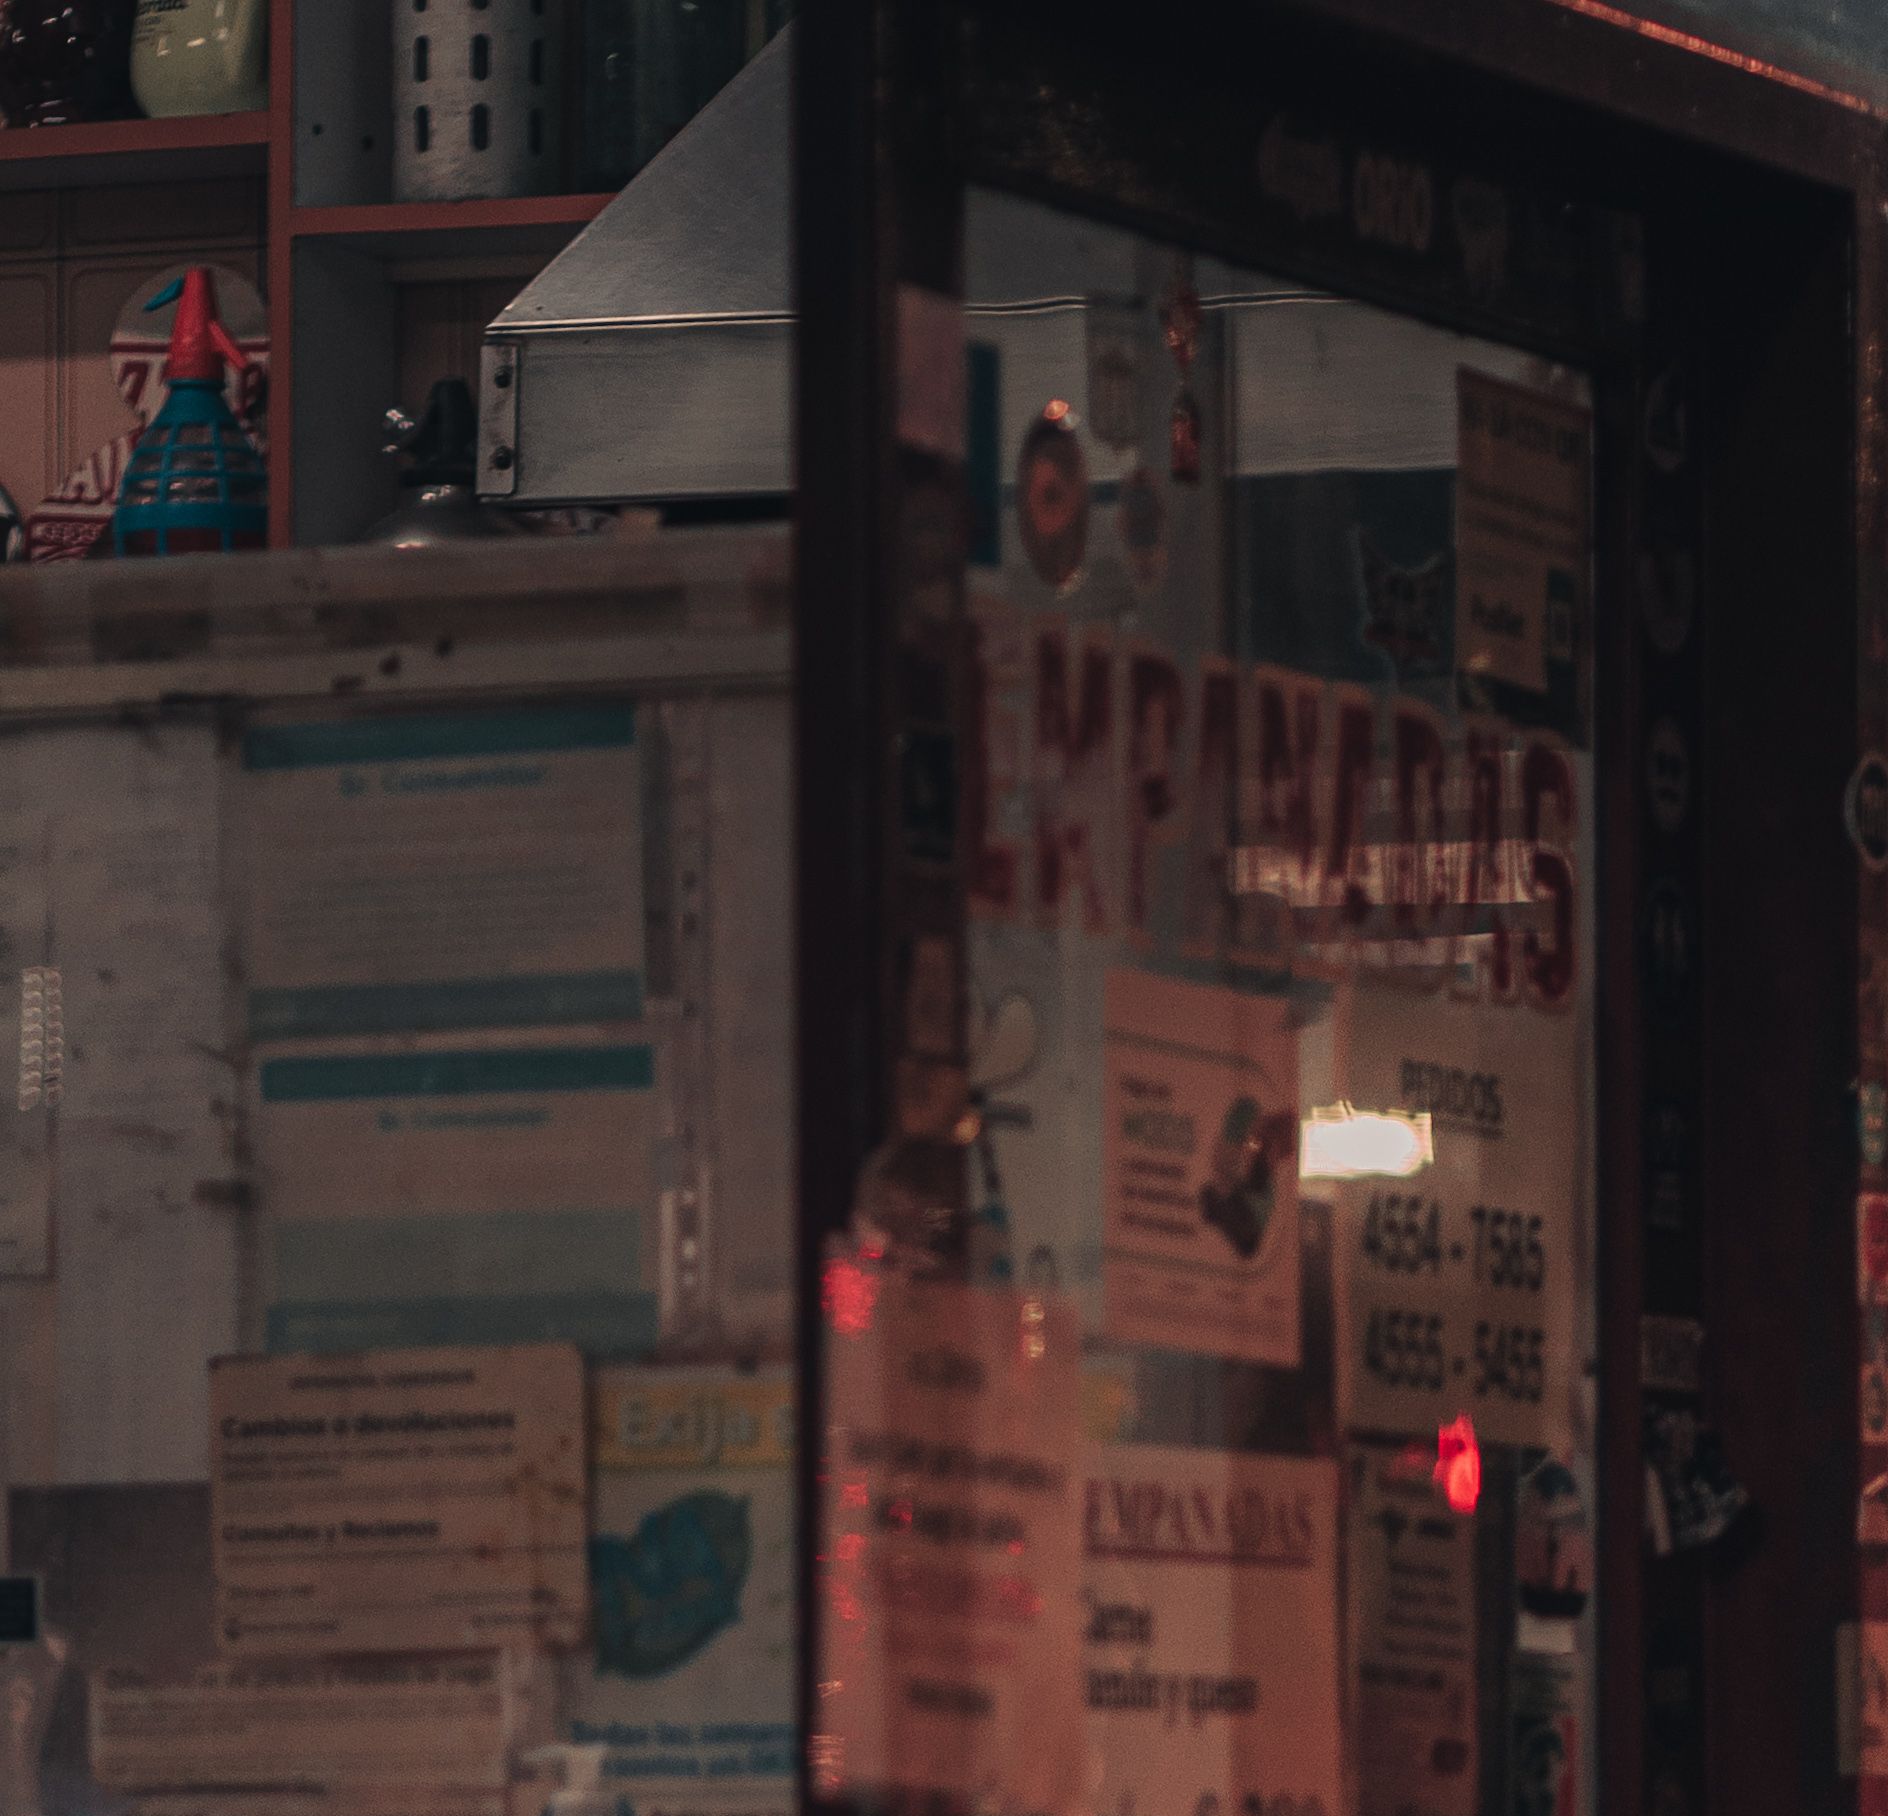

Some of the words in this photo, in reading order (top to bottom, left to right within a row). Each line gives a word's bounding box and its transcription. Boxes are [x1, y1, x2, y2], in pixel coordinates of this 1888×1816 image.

[966, 628, 1576, 1008] EMPANADAS
[1400, 1056, 1503, 1126] PEDIDOS
[1363, 1193, 1441, 1273] 4554
[1471, 1204, 1545, 1290] 7585
[1365, 1308, 1444, 1391] 4555
[1474, 1318, 1545, 1401] 5455
[1085, 1477, 1314, 1552] EMPANADAS
